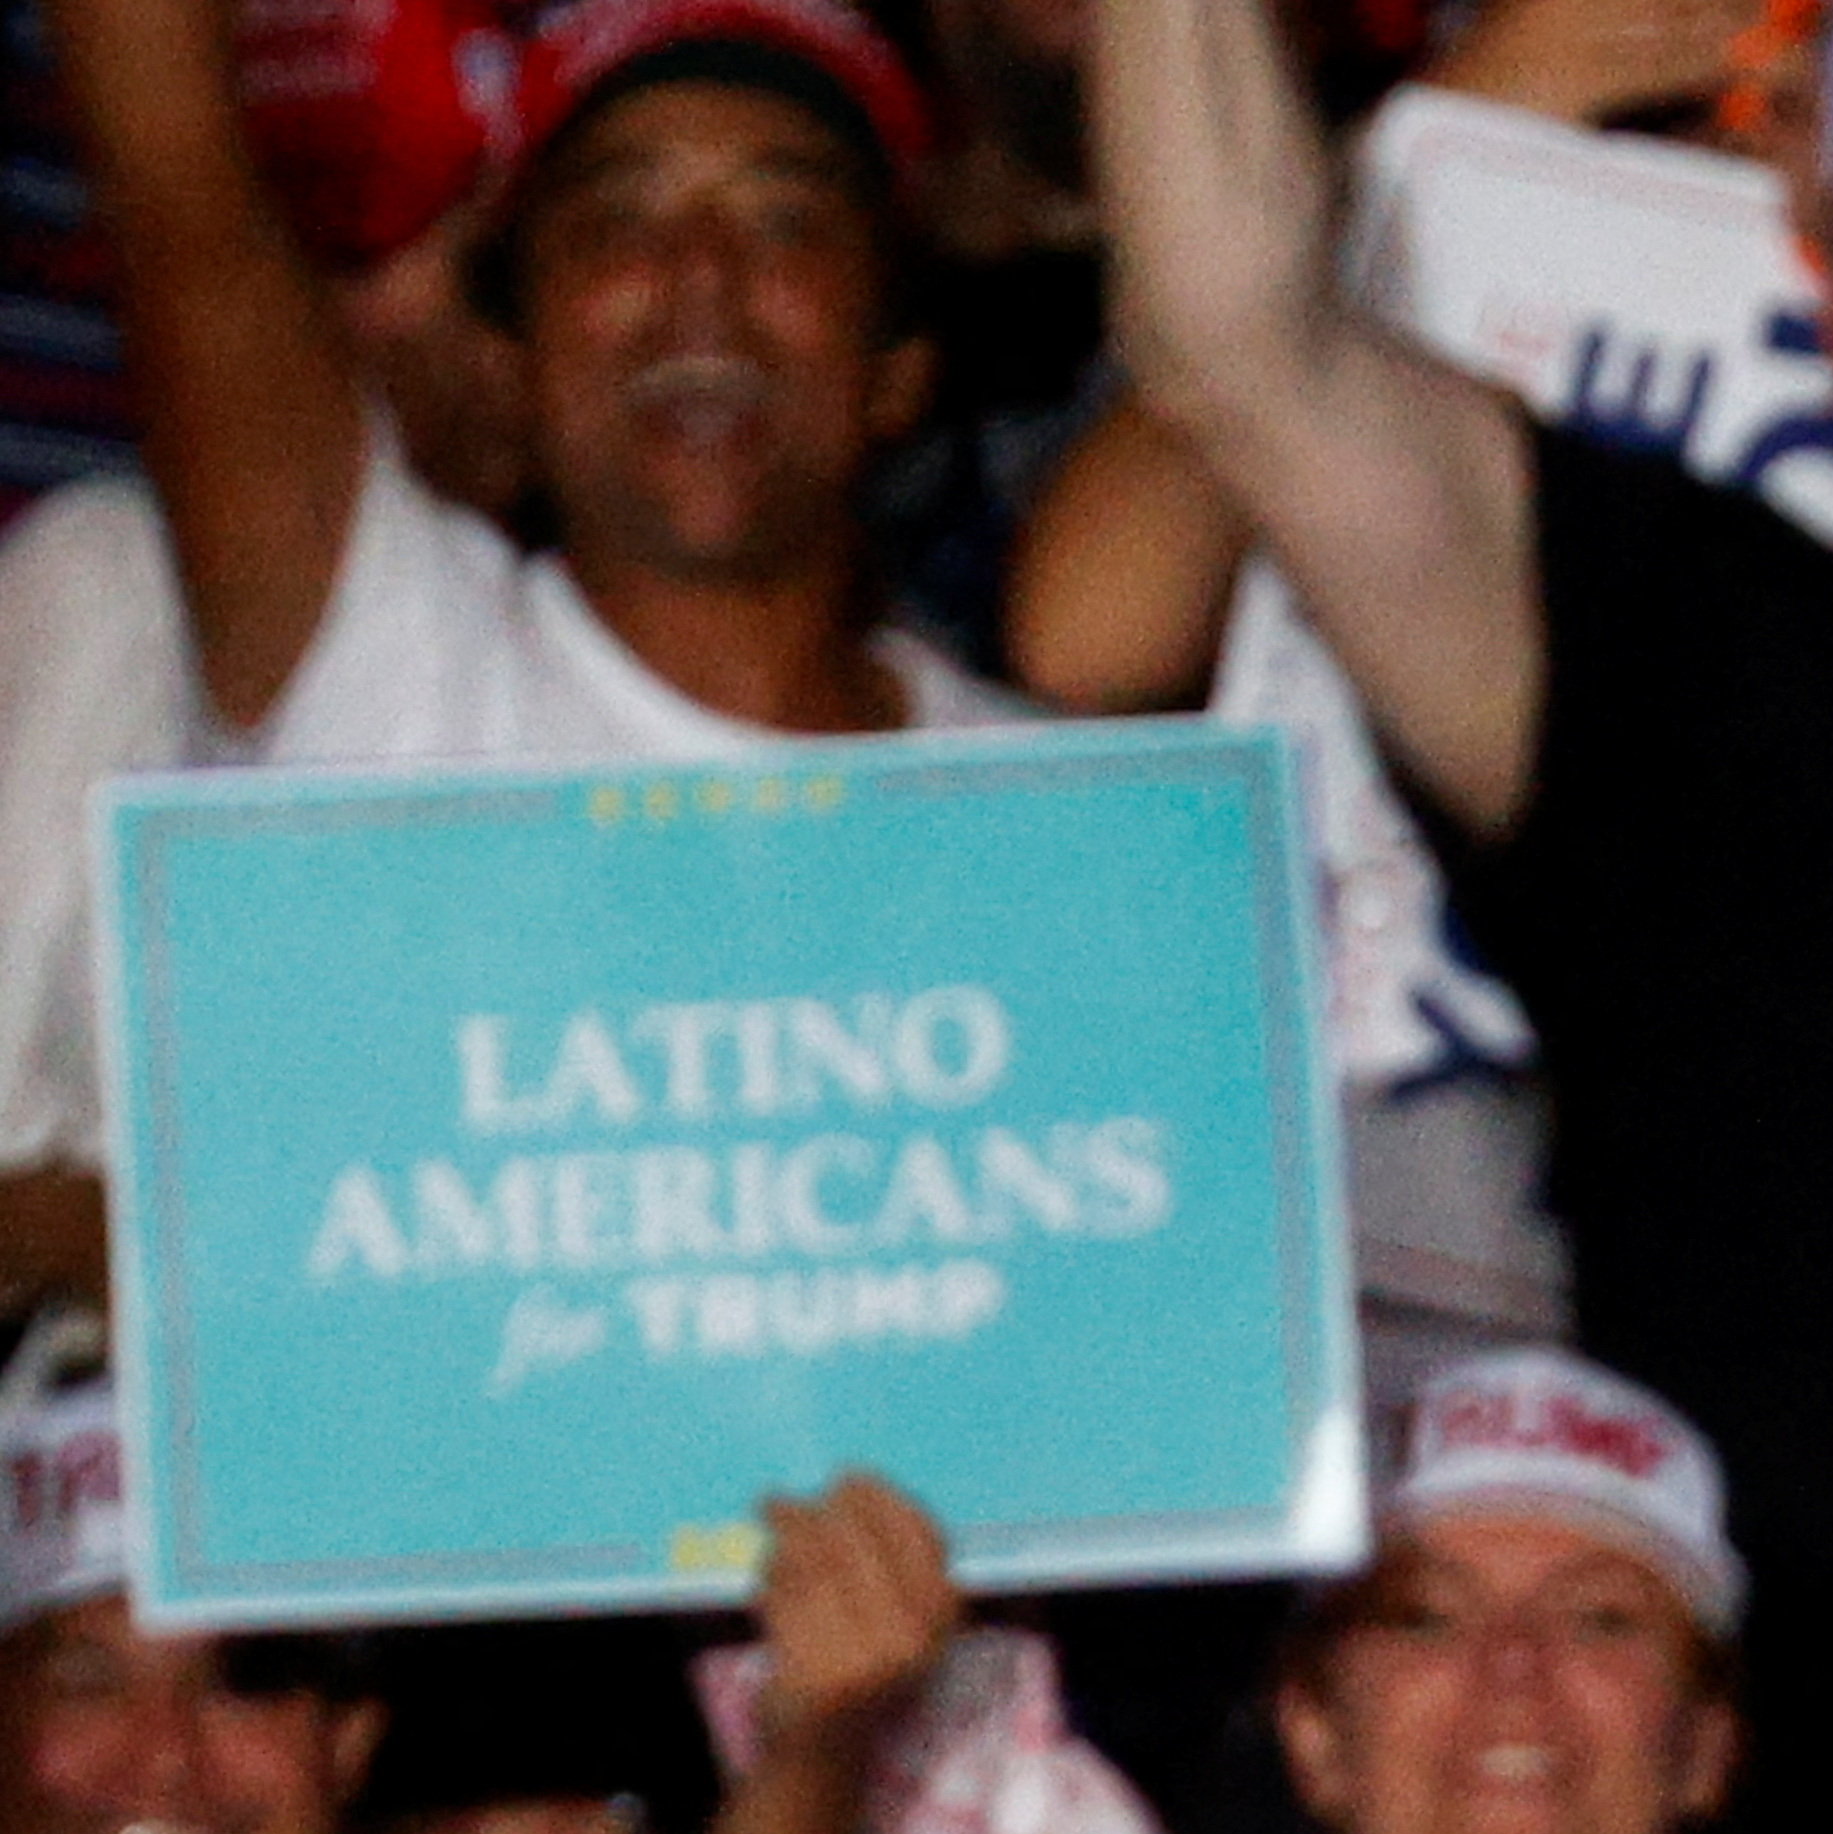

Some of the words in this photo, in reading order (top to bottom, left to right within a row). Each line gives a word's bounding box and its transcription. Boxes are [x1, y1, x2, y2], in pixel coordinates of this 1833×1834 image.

[455, 980, 1012, 1134] LATINO
[307, 1114, 1176, 1282] AMERICANS
[621, 1257, 1008, 1358] TRUMP
